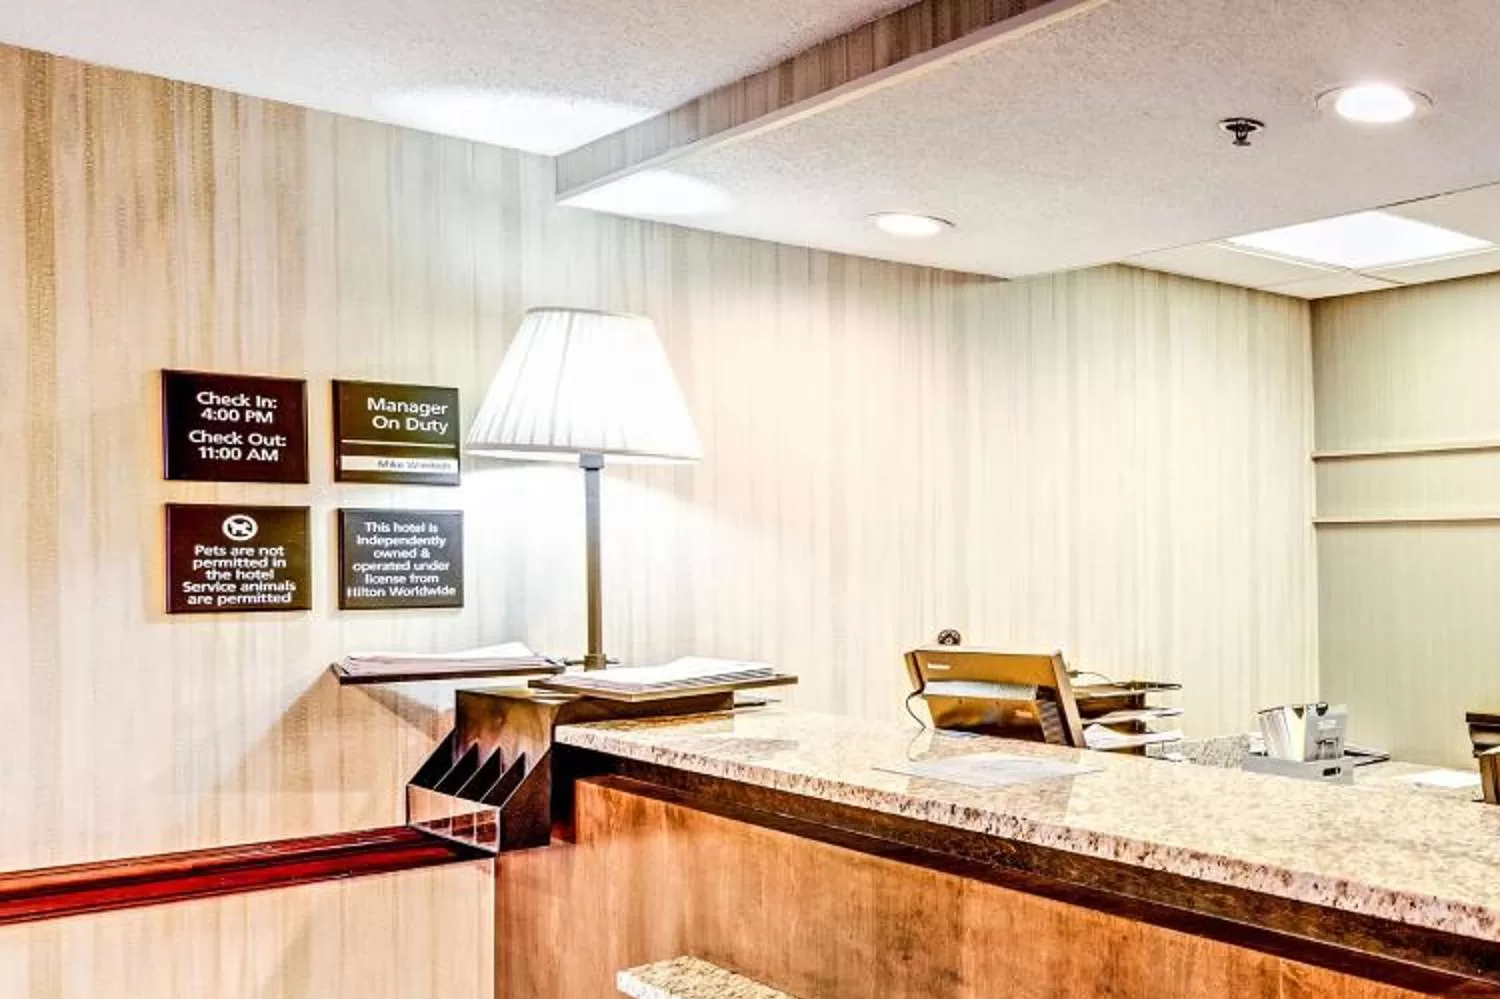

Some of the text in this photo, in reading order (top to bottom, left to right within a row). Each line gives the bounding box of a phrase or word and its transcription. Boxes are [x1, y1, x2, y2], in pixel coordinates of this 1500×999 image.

[196, 391, 277, 409] Check In:
[367, 397, 448, 417] Manager
[201, 408, 273, 424] 4:00 PM
[372, 415, 448, 435] On Duty
[188, 430, 287, 447] Check Out:
[198, 446, 279, 462] 11:00 AM
[364, 522, 438, 533] This hotel is
[194, 544, 285, 557] Pets are not
[373, 548, 431, 559] owned &
[192, 556, 287, 570] permitted in
[352, 560, 450, 572] operated under
[205, 569, 275, 580] the hotel
[365, 573, 439, 584] license from
[182, 580, 297, 593] Service animals
[347, 586, 457, 597] Hilton Worldwide
[187, 592, 292, 606] are permitted
